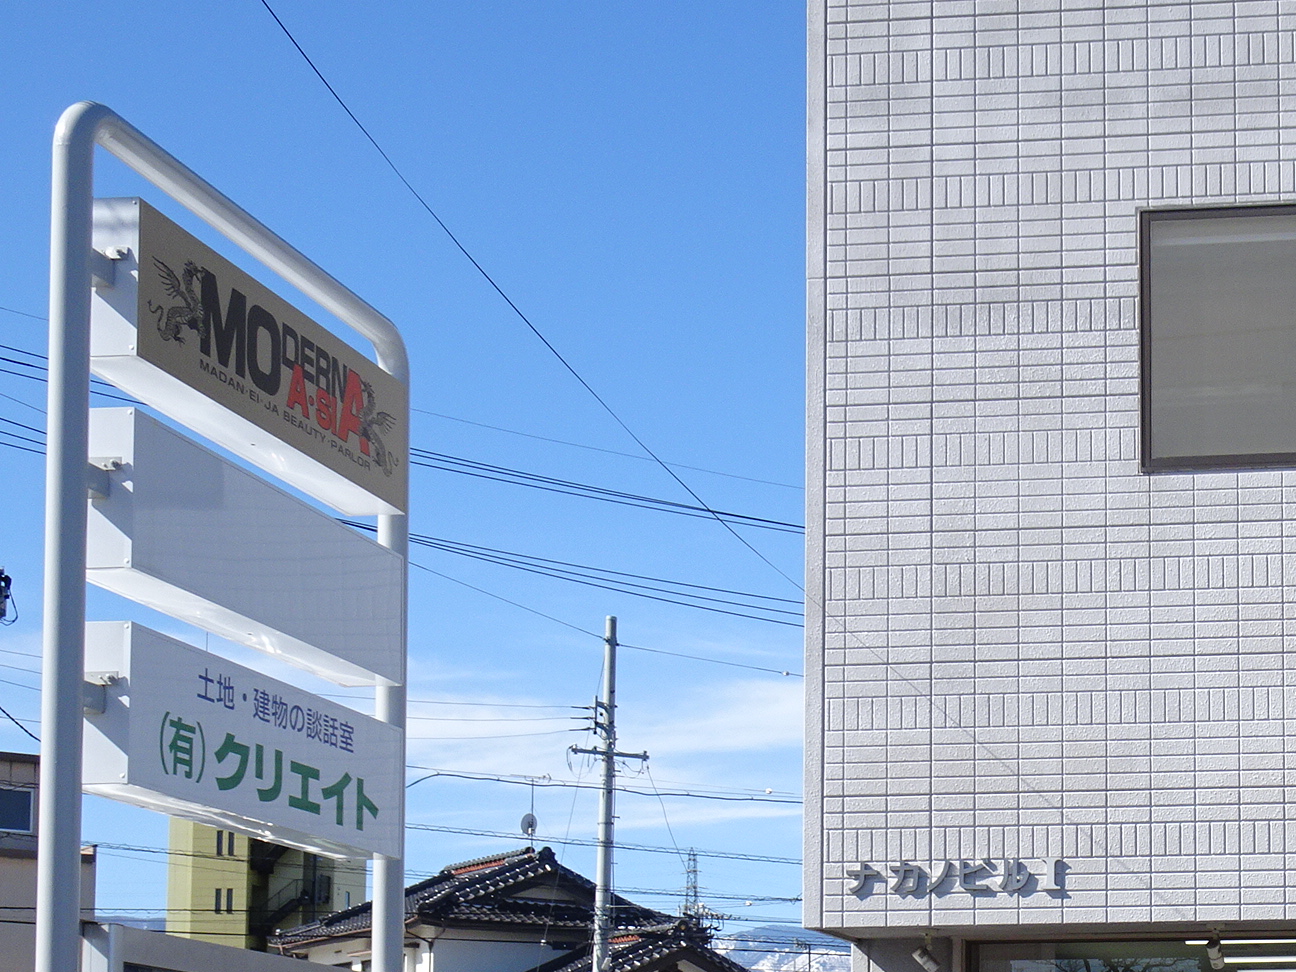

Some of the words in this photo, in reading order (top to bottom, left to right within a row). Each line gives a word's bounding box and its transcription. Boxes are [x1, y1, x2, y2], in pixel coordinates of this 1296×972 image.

[196, 667, 356, 754] 土地・建物の談話室
